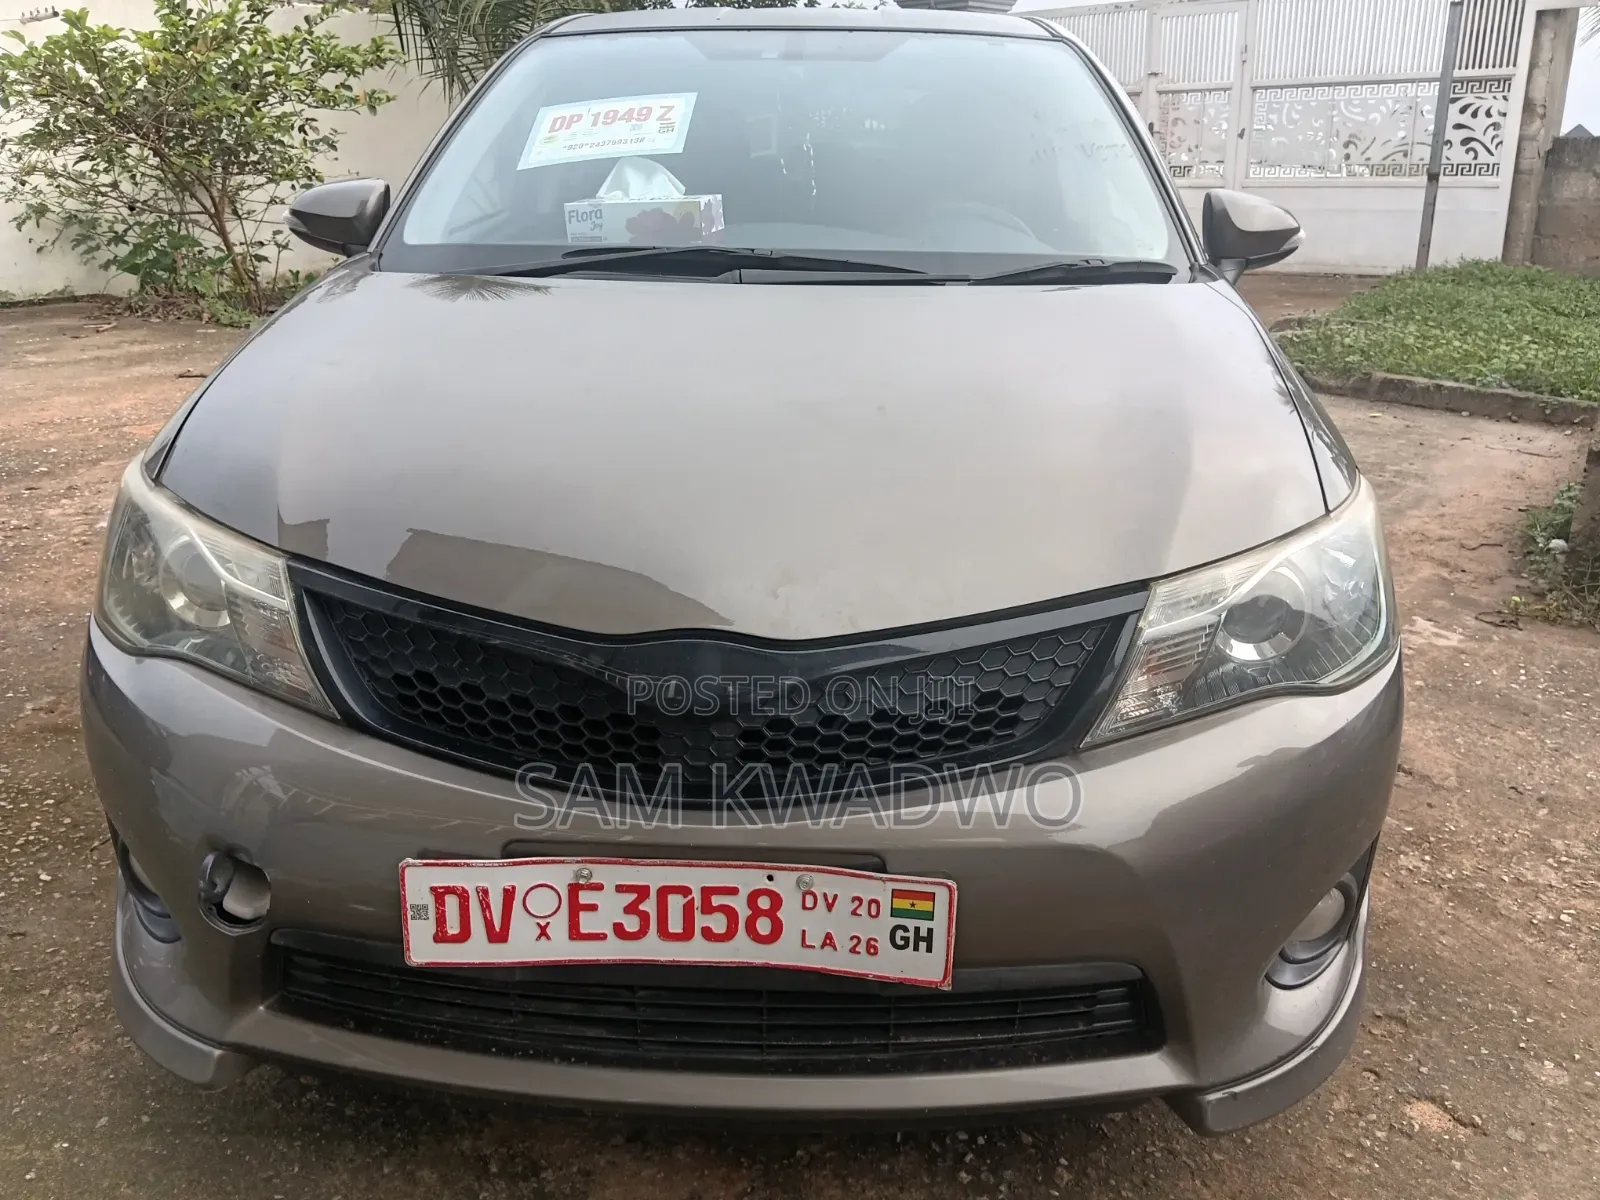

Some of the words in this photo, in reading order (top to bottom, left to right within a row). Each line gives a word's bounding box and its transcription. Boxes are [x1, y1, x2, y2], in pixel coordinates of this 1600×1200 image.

[548, 113, 584, 133] DP
[590, 106, 653, 128] 1949
[656, 106, 675, 121] Z
[568, 208, 603, 224] Flora
[430, 884, 517, 943] DV
[567, 882, 784, 945] E3058
[801, 889, 839, 912] DV
[850, 896, 881, 918] 20
[801, 929, 838, 951] LA
[849, 934, 879, 956] 26
[889, 924, 934, 953] GH
